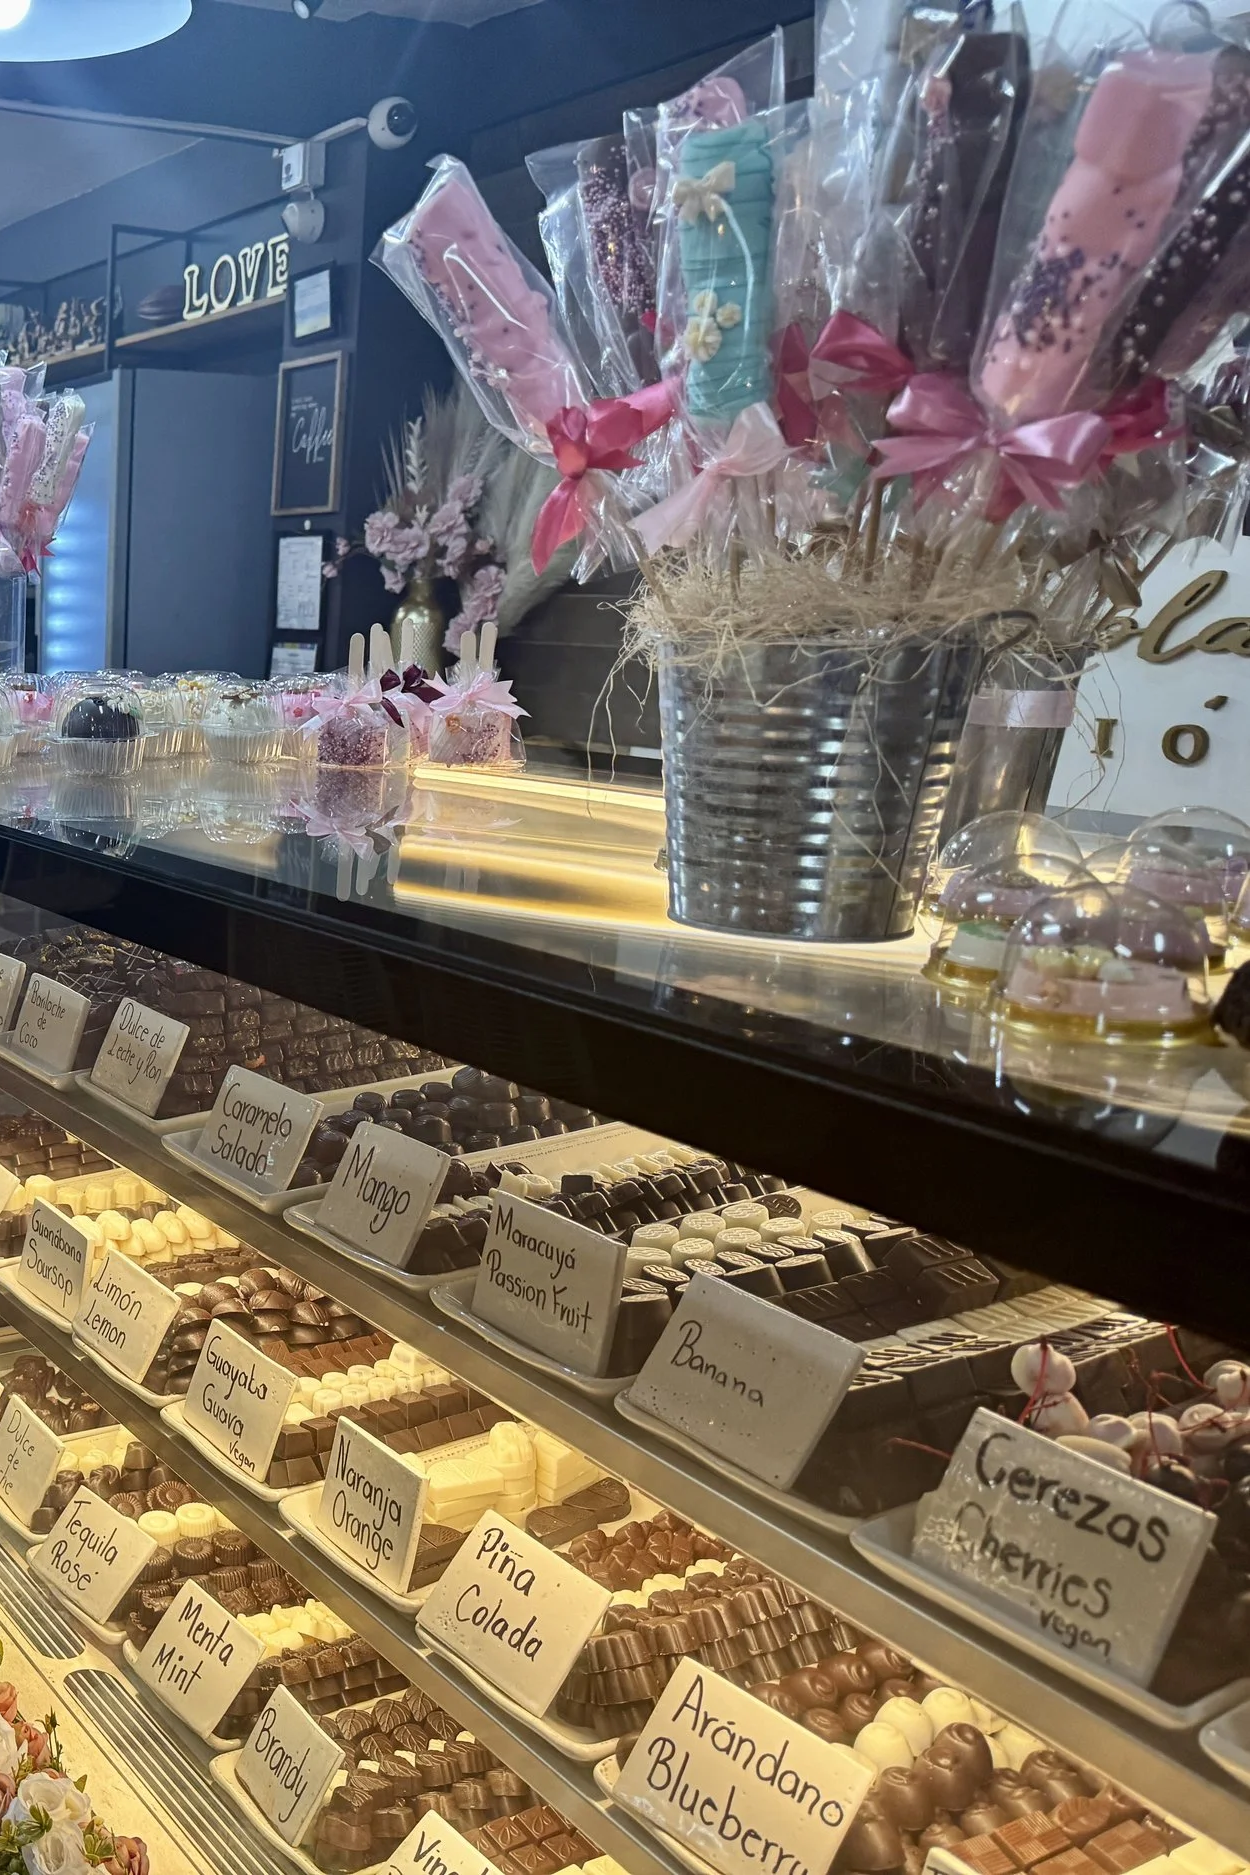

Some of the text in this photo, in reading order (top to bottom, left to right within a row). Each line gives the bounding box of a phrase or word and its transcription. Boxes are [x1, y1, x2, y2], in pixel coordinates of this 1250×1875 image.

[183, 232, 289, 320] LOVE
[31, 980, 66, 1019] Bariloche
[37, 1012, 47, 1030] de
[119, 1002, 166, 1049] Dulce de
[19, 1022, 38, 1048] Coco
[107, 1033, 162, 1085] Leche y Ron
[222, 1083, 293, 1139] Caramelo
[211, 1123, 269, 1177] Salado
[342, 1144, 411, 1235] Mango
[31, 1208, 82, 1264] Guanábana
[495, 1205, 577, 1279] Maracuyá
[27, 1238, 74, 1308] Soursop
[93, 1256, 143, 1321] Limón
[486, 1248, 594, 1335] Passion Fruit
[83, 1298, 127, 1350] Lemon
[670, 1319, 765, 1408] Banana
[6, 1409, 35, 1457] Dulce
[202, 1382, 245, 1439] Guava
[7, 1447, 20, 1470] de
[335, 1435, 402, 1530] Naranja
[332, 1490, 395, 1570] Orange
[975, 1432, 1170, 1564] Cerezas
[65, 1500, 118, 1566] Tequila
[476, 1527, 536, 1597] Piña
[954, 1501, 1113, 1619] Cherries
[51, 1540, 99, 1592] Rosé
[178, 1596, 235, 1667] Menta
[455, 1584, 543, 1662] Colada
[152, 1643, 203, 1694] Mint
[254, 1707, 311, 1823] Brandy
[671, 1674, 845, 1828] Arándano
[413, 1831, 459, 1875] Vin
